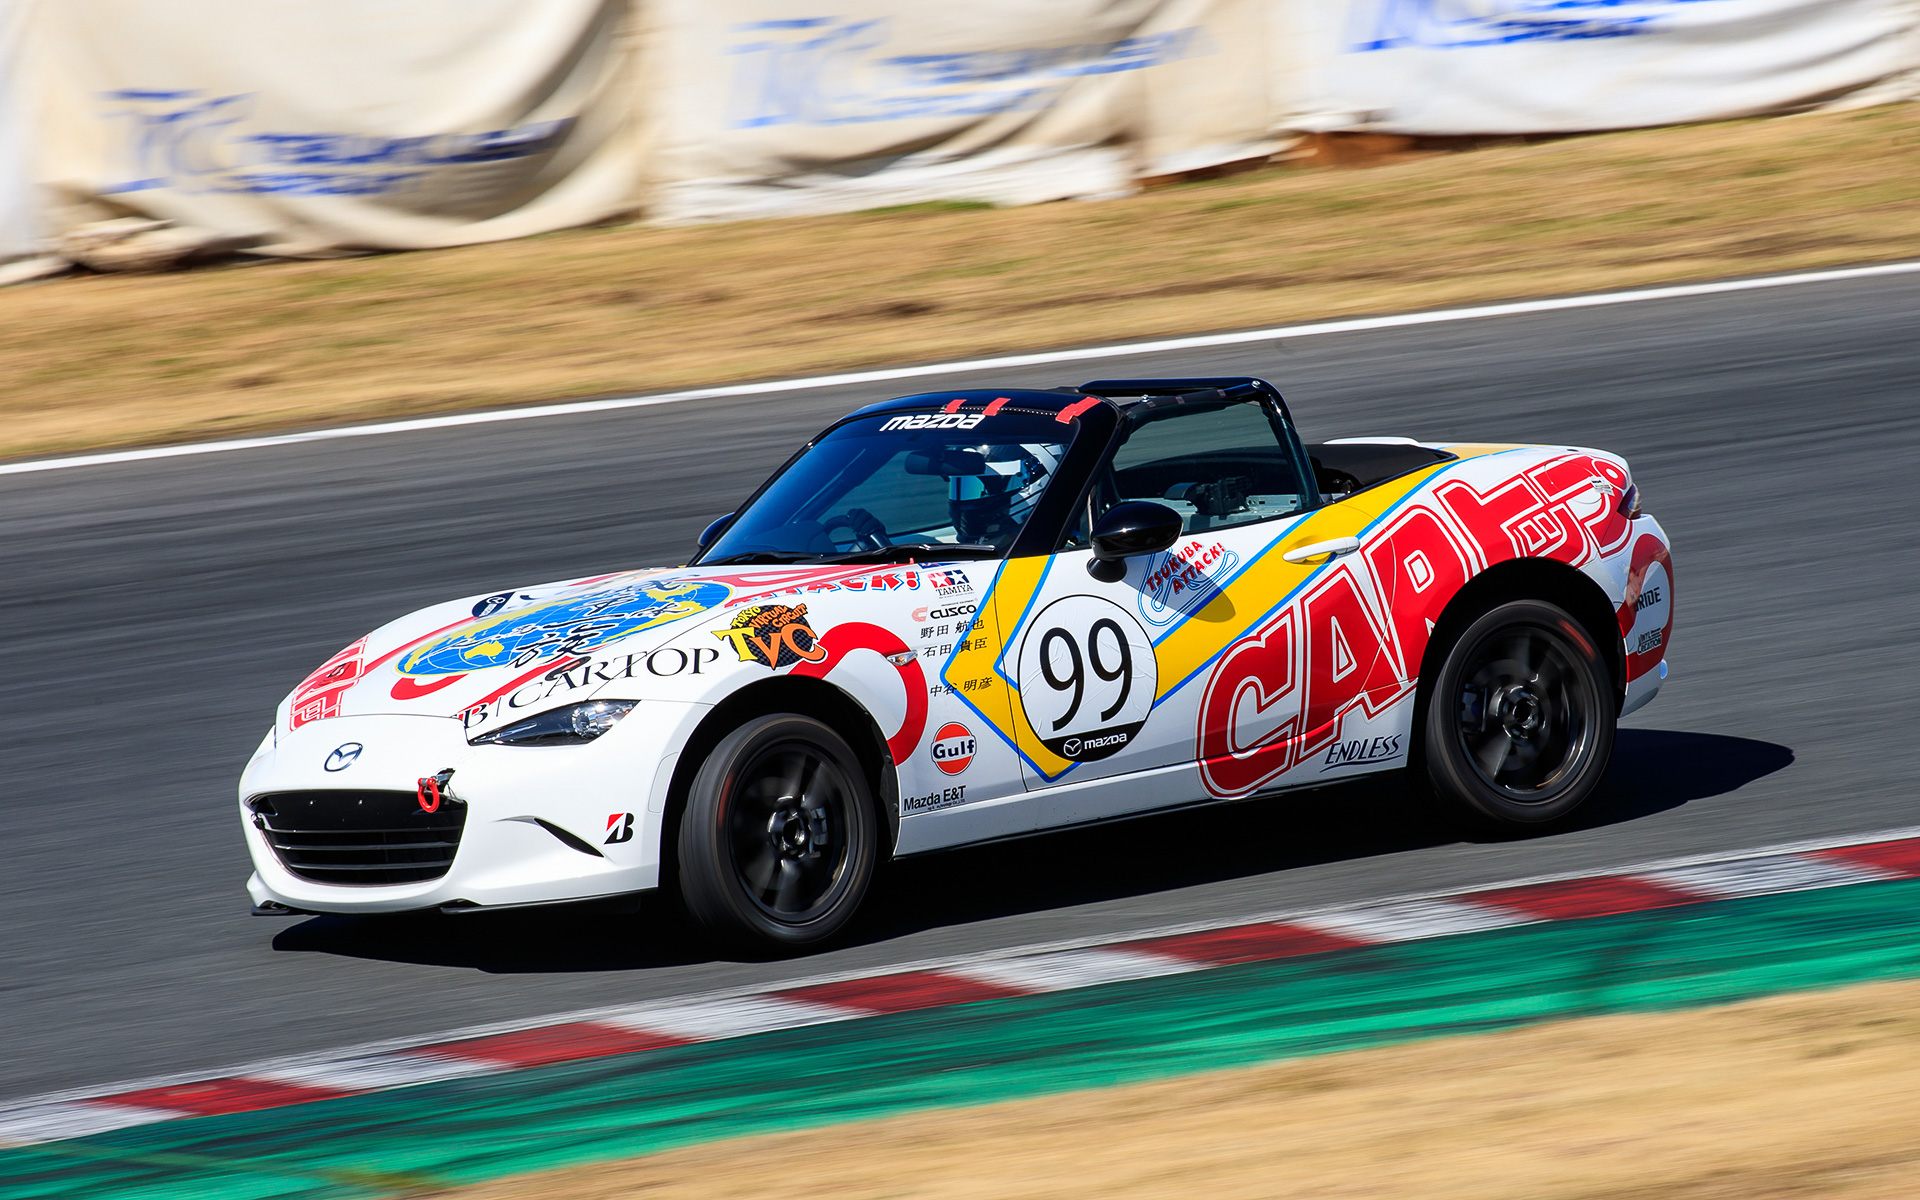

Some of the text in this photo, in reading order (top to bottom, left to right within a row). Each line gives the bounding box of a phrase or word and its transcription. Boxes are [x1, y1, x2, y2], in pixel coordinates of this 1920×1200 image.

[879, 414, 986, 432] mazda
[1146, 541, 1203, 592] TSUKUBA
[1172, 542, 1226, 594] ATTACK!
[936, 584, 974, 596] TAMIYA
[731, 606, 762, 628] TOKYO
[748, 604, 789, 630] VIRTUAL
[772, 603, 808, 628] CIRCUIT
[920, 624, 949, 639] 野田
[711, 622, 826, 670] TVC
[923, 637, 987, 657] 石田 貴臣
[1039, 618, 1133, 731] 99
[930, 676, 992, 697] 中谷 明彦
[933, 739, 974, 759] Gulf
[1084, 733, 1127, 750] mazda
[1325, 733, 1402, 765] ENDLESS
[903, 792, 941, 811] Mazda
[943, 785, 966, 802] E&T
